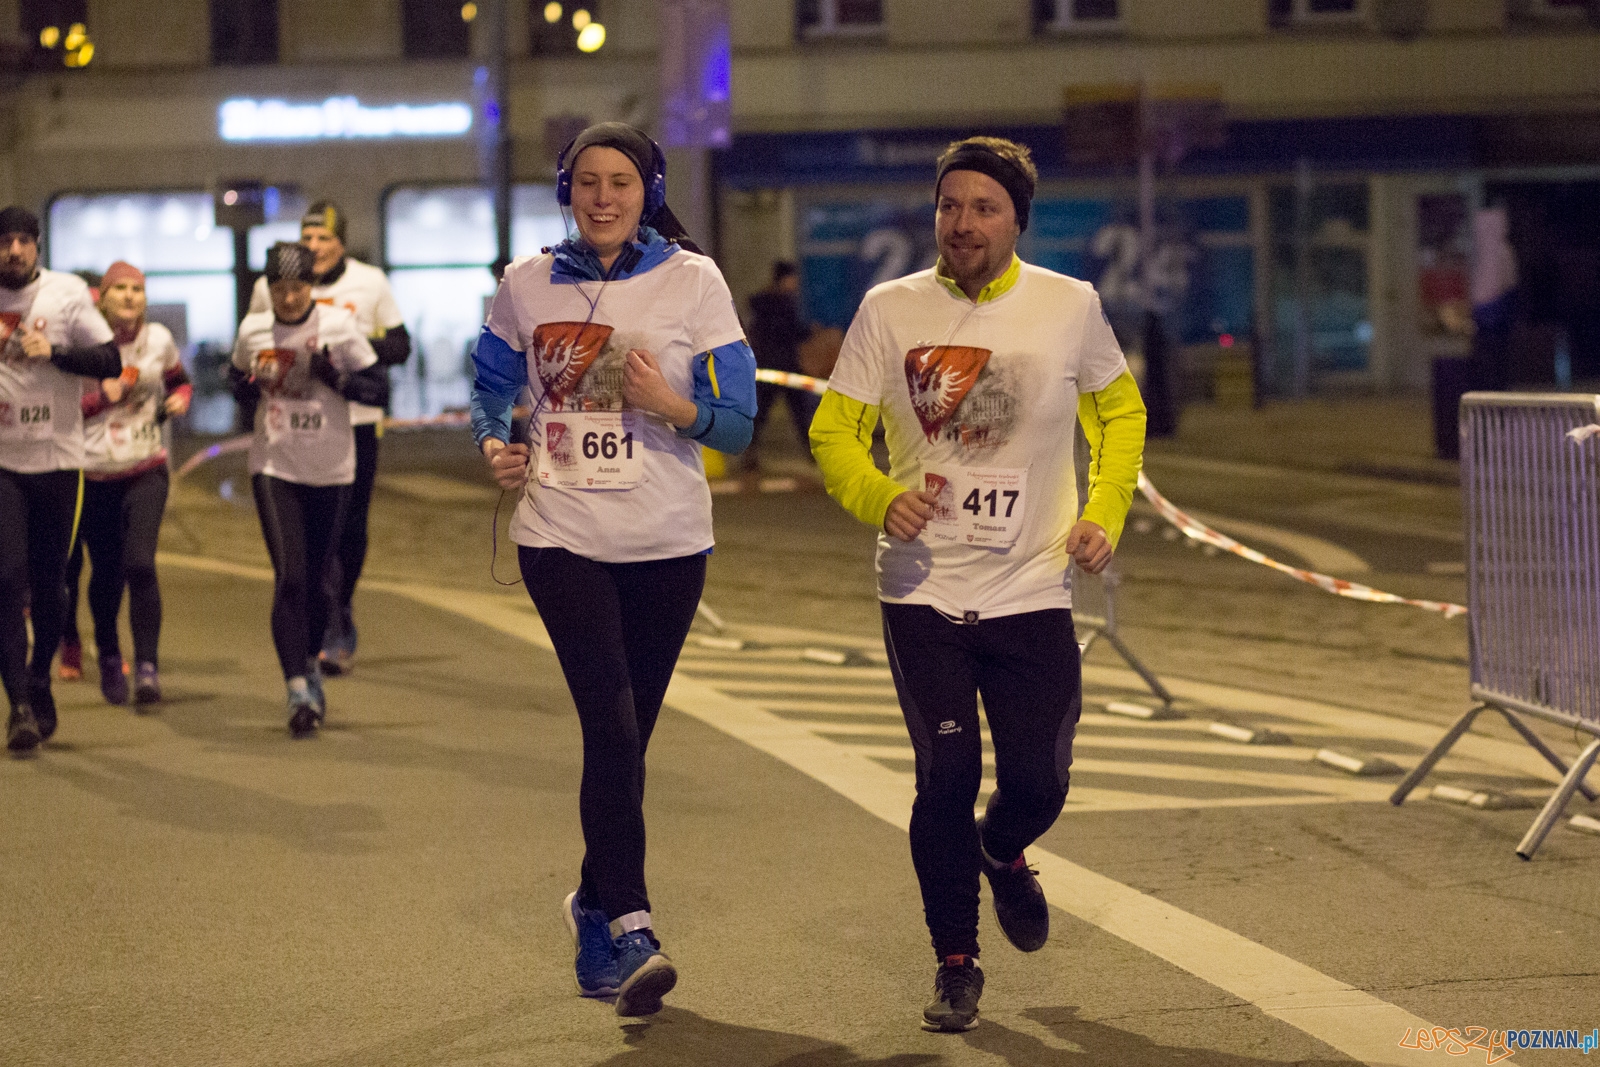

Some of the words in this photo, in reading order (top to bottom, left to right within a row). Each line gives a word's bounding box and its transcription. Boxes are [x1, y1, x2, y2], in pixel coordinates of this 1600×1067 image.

[20, 404, 51, 423] 828
[291, 412, 322, 430] 829
[582, 431, 633, 459] 661
[962, 488, 1020, 518] 417
[972, 523, 1007, 532] Tomasz
